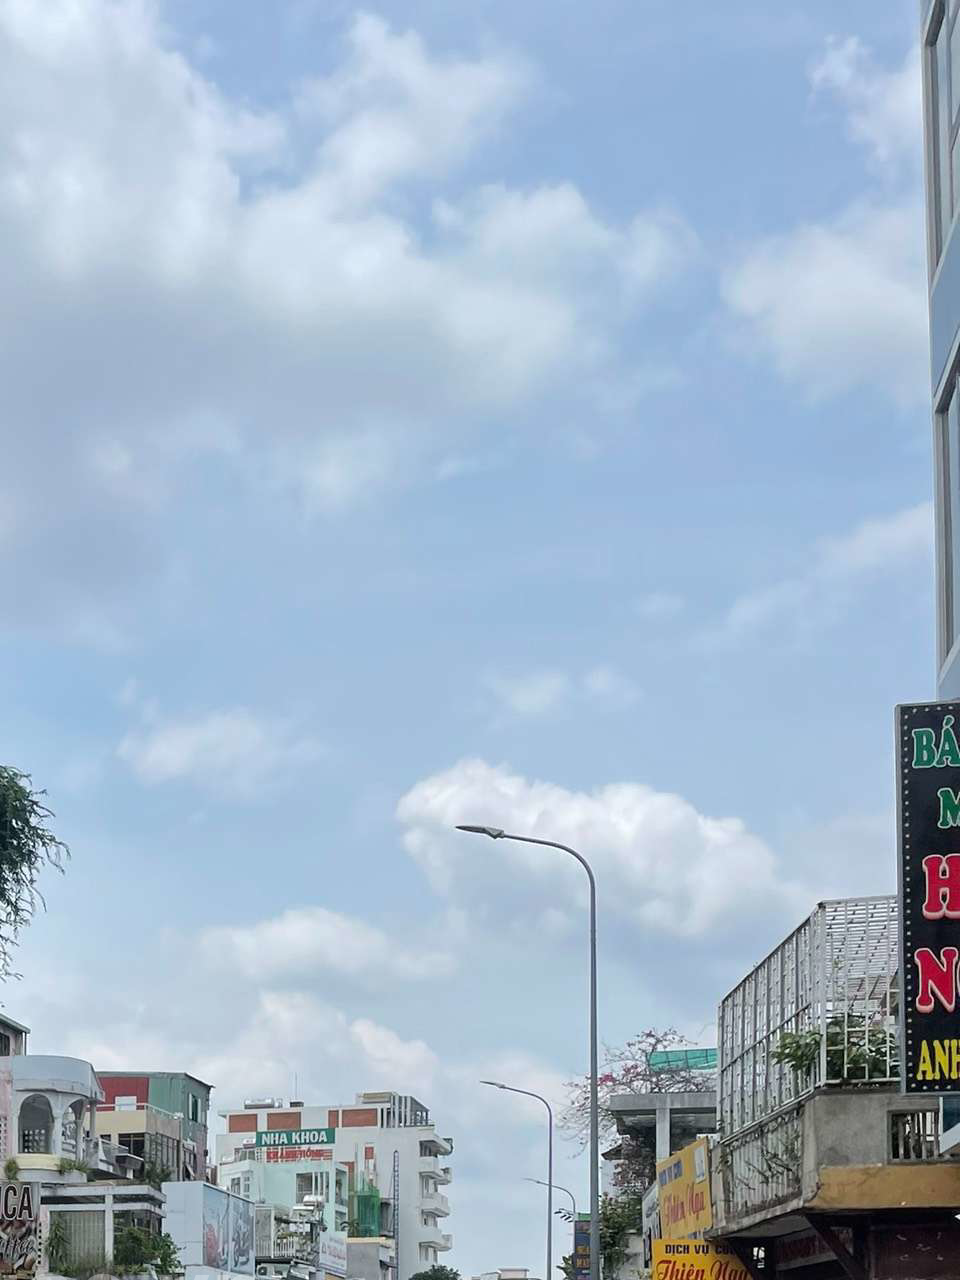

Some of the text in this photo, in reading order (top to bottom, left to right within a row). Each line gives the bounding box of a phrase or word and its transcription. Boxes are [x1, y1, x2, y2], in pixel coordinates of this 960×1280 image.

[261, 1130, 328, 1146] NHA KHOA
[665, 1244, 691, 1258] DỊCH
